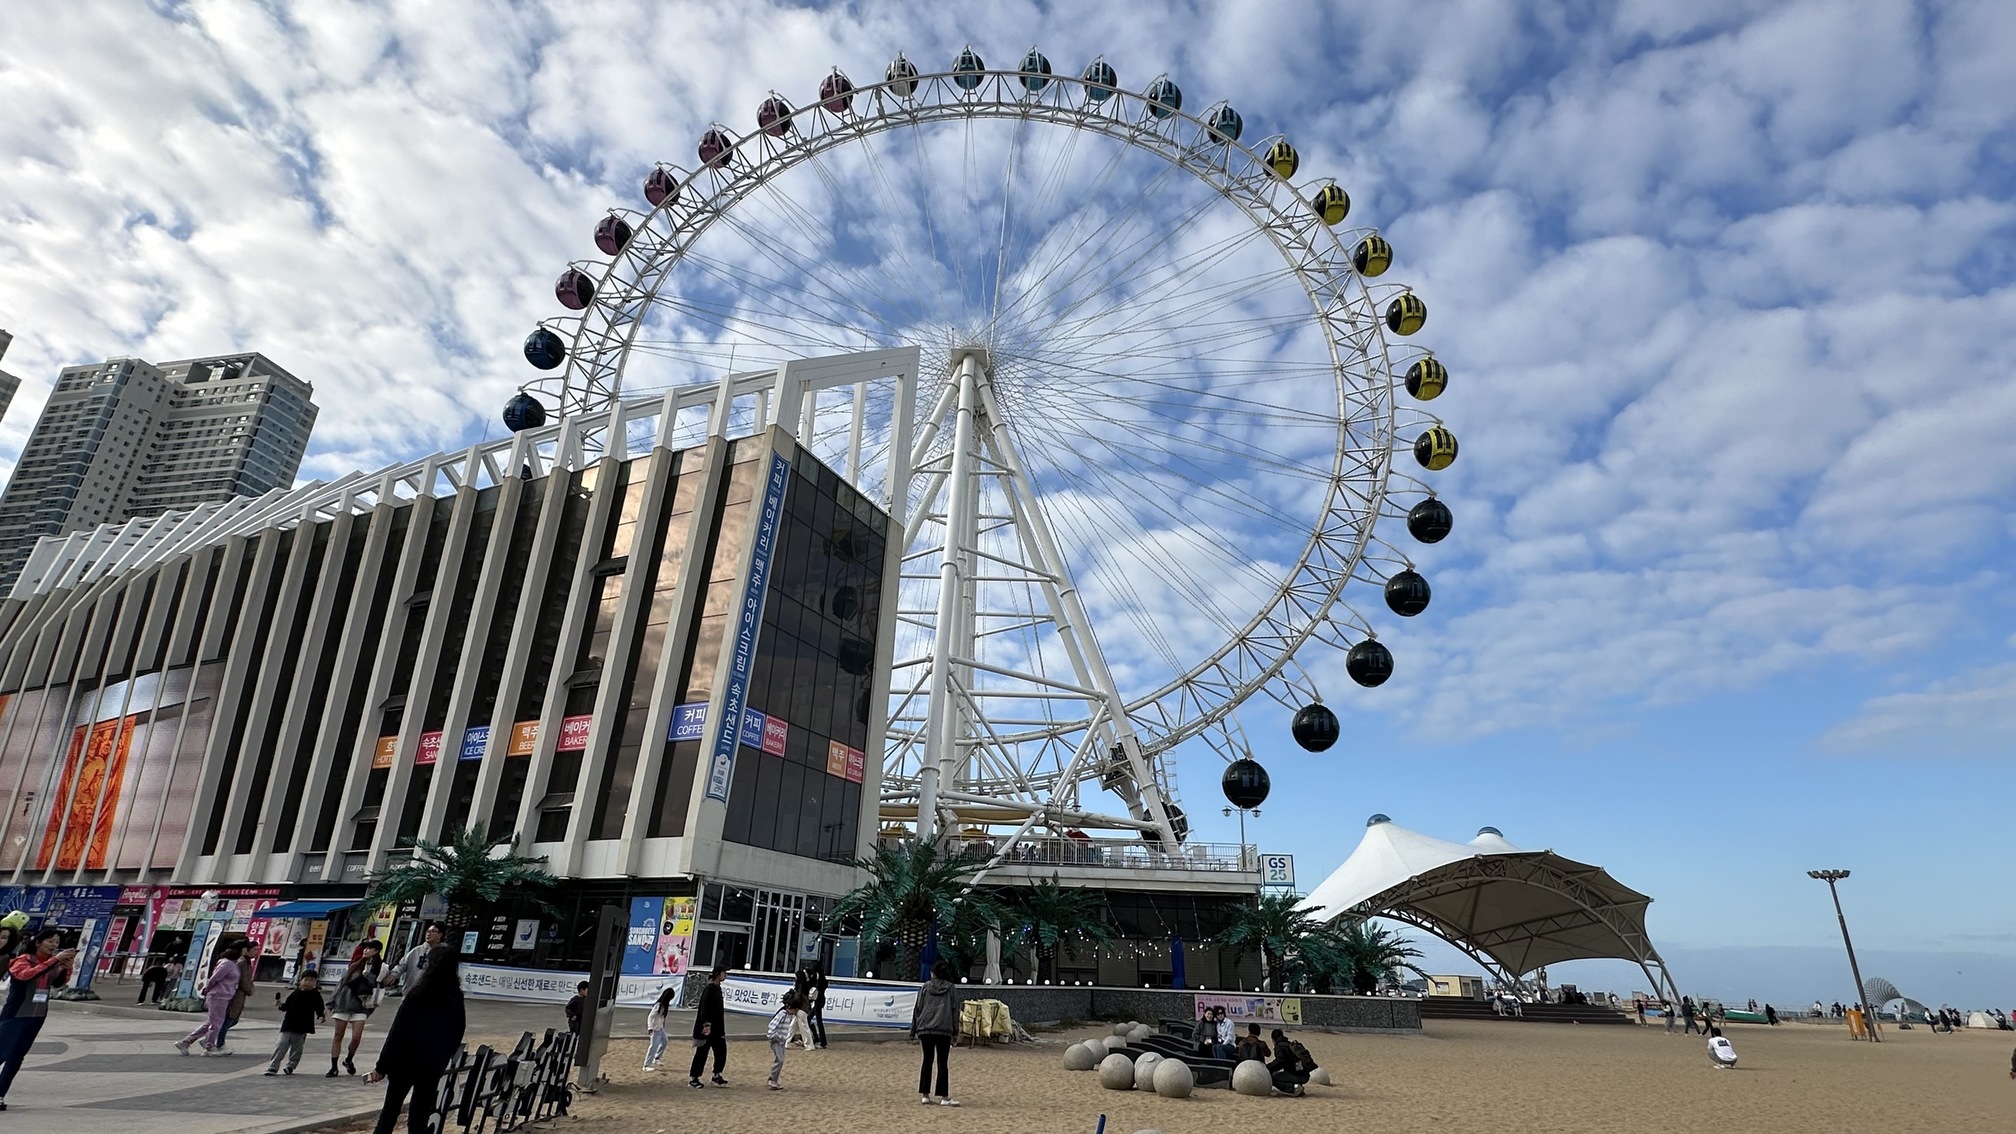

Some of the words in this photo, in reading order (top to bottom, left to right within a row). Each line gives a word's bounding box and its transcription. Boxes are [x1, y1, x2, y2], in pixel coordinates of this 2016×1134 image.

[773, 460, 785, 488] 커피
[760, 495, 778, 551] 베이커리
[751, 558, 765, 588] 맥주
[737, 597, 757, 672] 아이스크림
[684, 707, 706, 722] 커피
[722, 682, 741, 744] 속초샌드
[745, 714, 761, 731] 커피
[522, 726, 539, 739] 맥주
[742, 729, 760, 742] COFFEE
[767, 722, 785, 740] 베이커리
[464, 746, 474, 755] ICE
[765, 738, 783, 750] BAKERY
[832, 748, 844, 761] 맥주
[346, 864, 364, 872] COFFE
[1268, 857, 1286, 869] GS
[1269, 869, 1287, 881] 25
[465, 972, 497, 987] 속초샌드는
[514, 975, 535, 990] 신선한
[535, 976, 557, 991] 재료로
[616, 983, 638, 996] 니다.
[735, 989, 759, 1004] 맛있는
[761, 991, 779, 1006] 빵과
